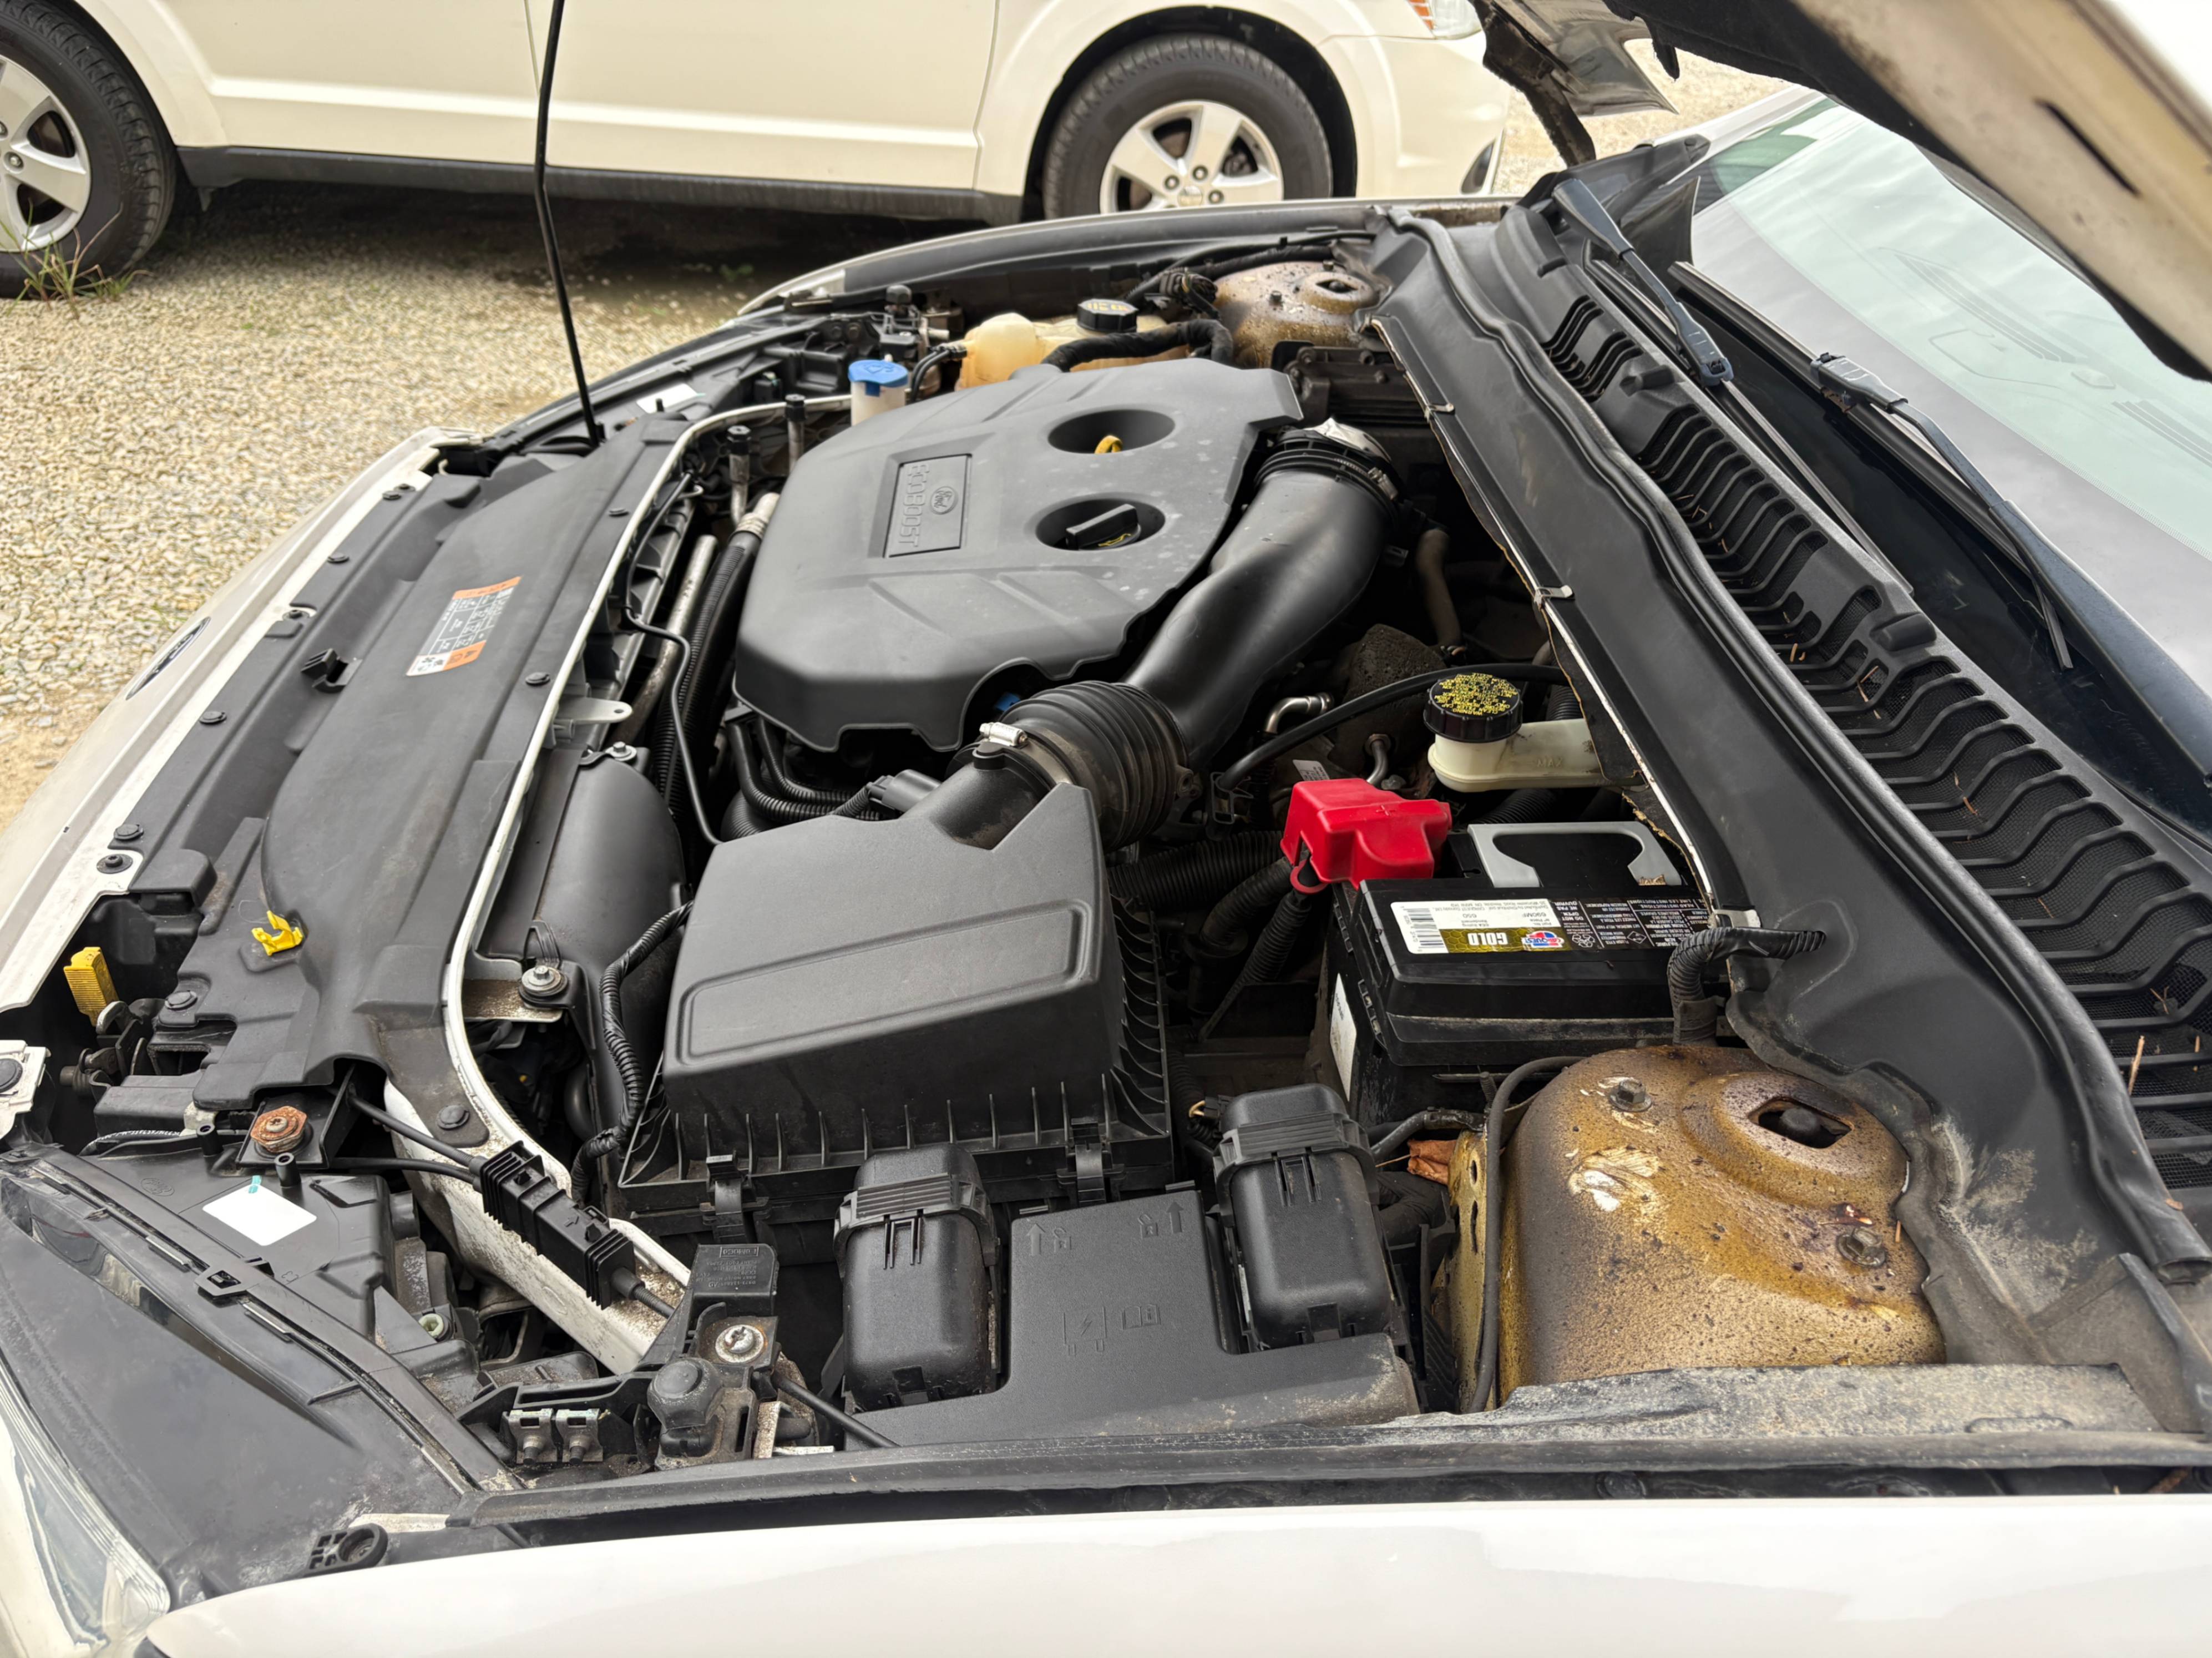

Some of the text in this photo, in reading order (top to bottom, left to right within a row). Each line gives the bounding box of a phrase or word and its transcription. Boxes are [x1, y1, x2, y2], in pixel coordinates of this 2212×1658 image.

[898, 464, 930, 547] ECOBOOST
[933, 489, 953, 509] Ford
[1467, 932, 1508, 946] GOLD
